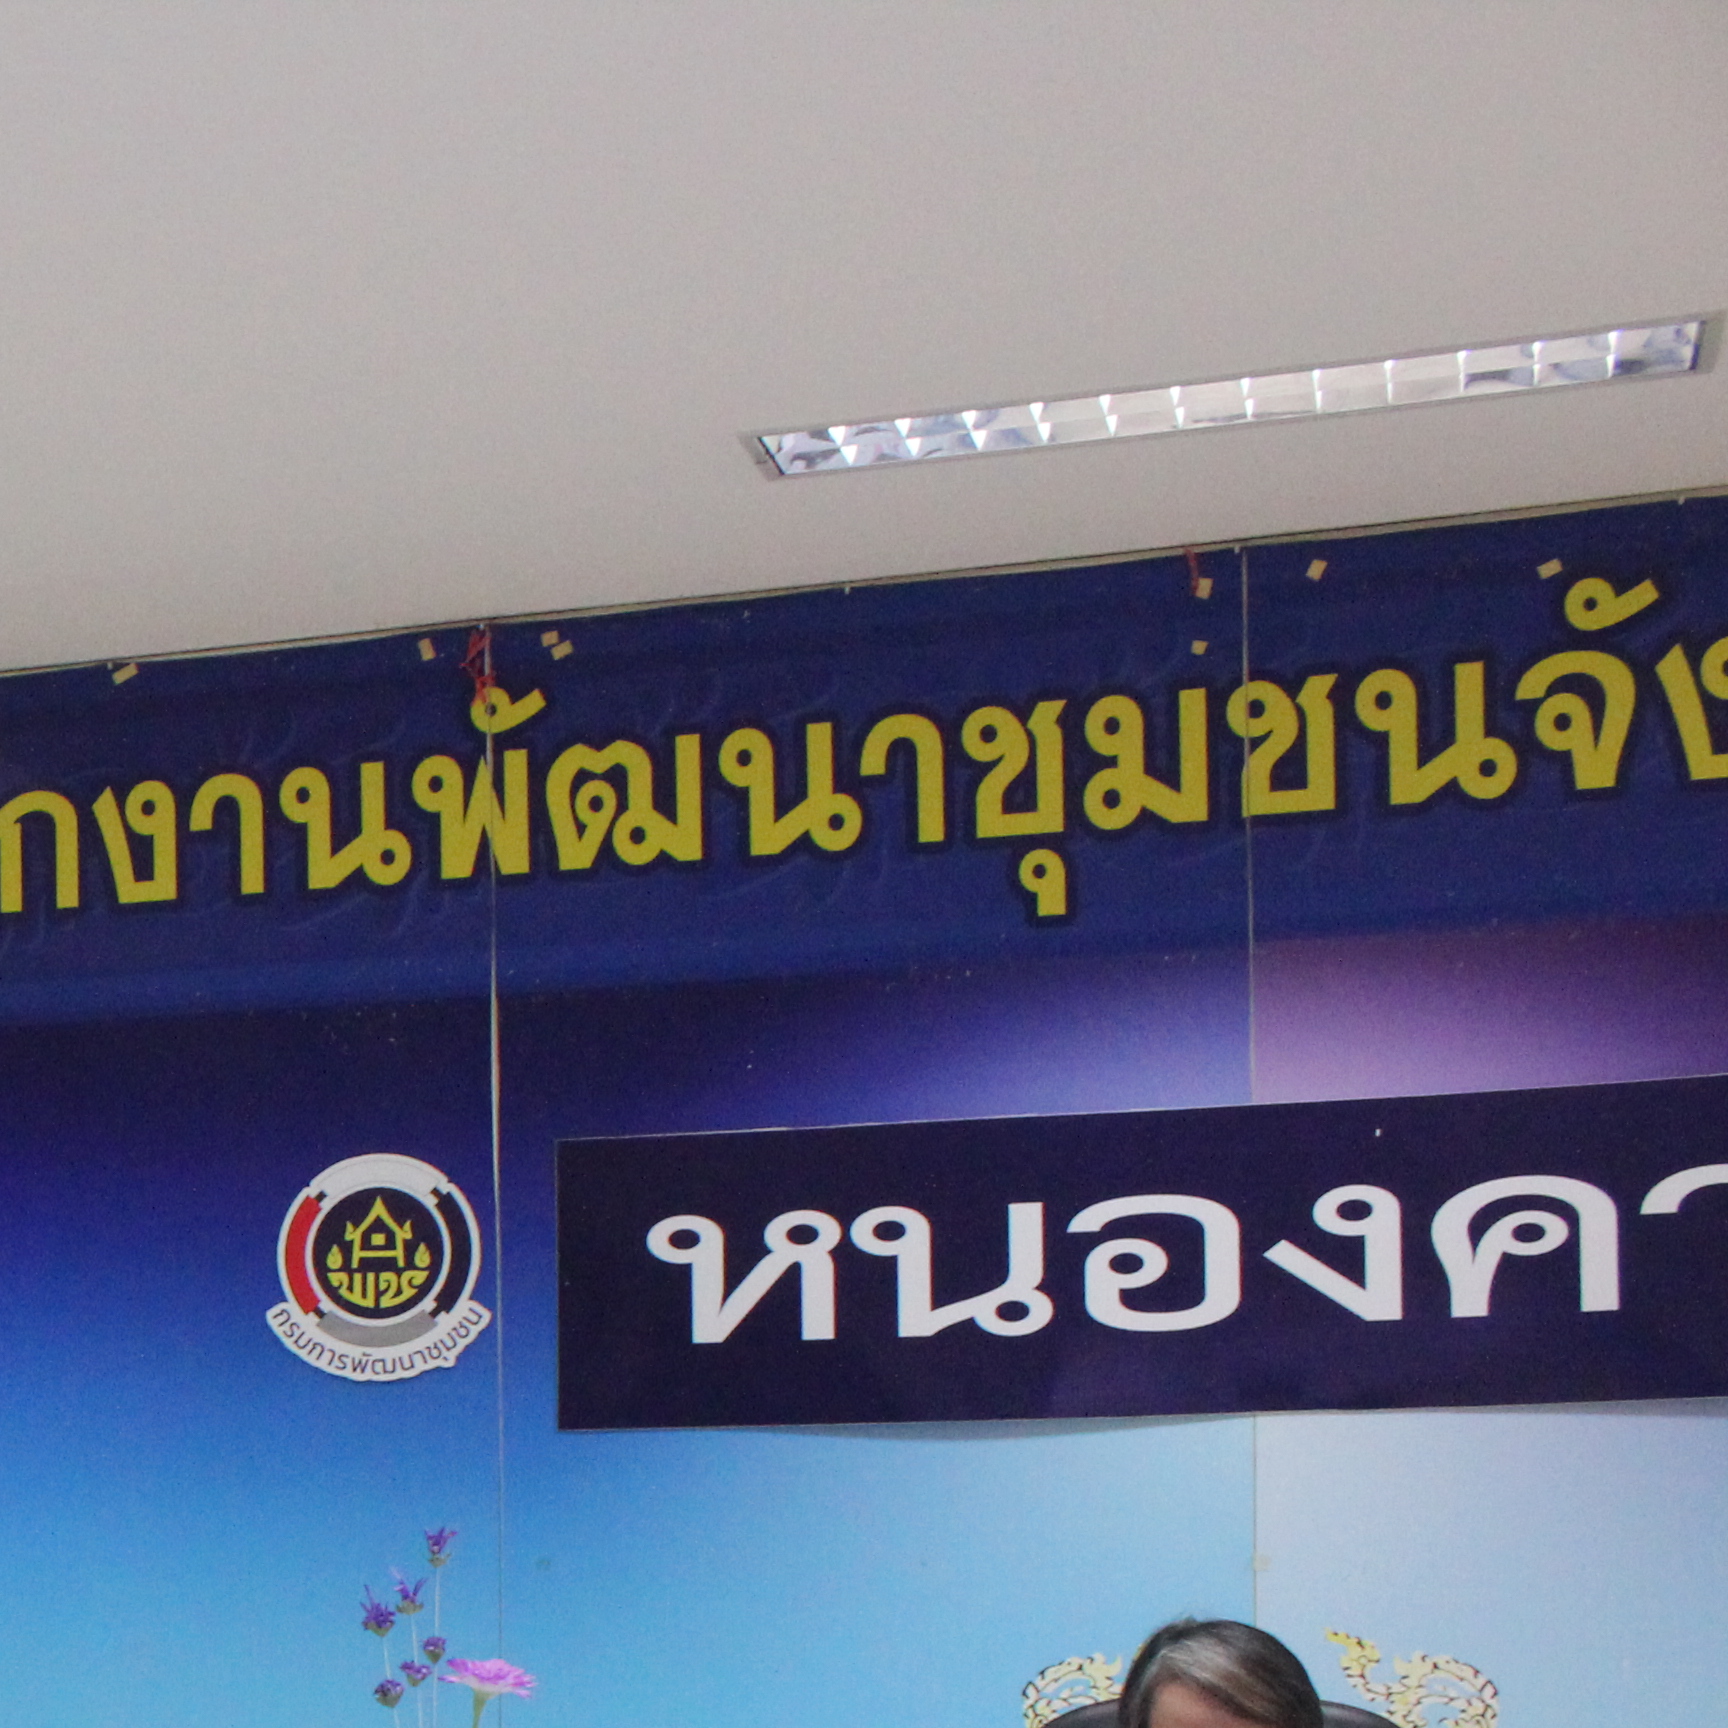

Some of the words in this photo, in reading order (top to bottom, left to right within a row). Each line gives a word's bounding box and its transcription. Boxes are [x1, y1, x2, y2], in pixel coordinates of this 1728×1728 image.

[272, 1307, 483, 1375] กรมการพัฒนาชุมชน
